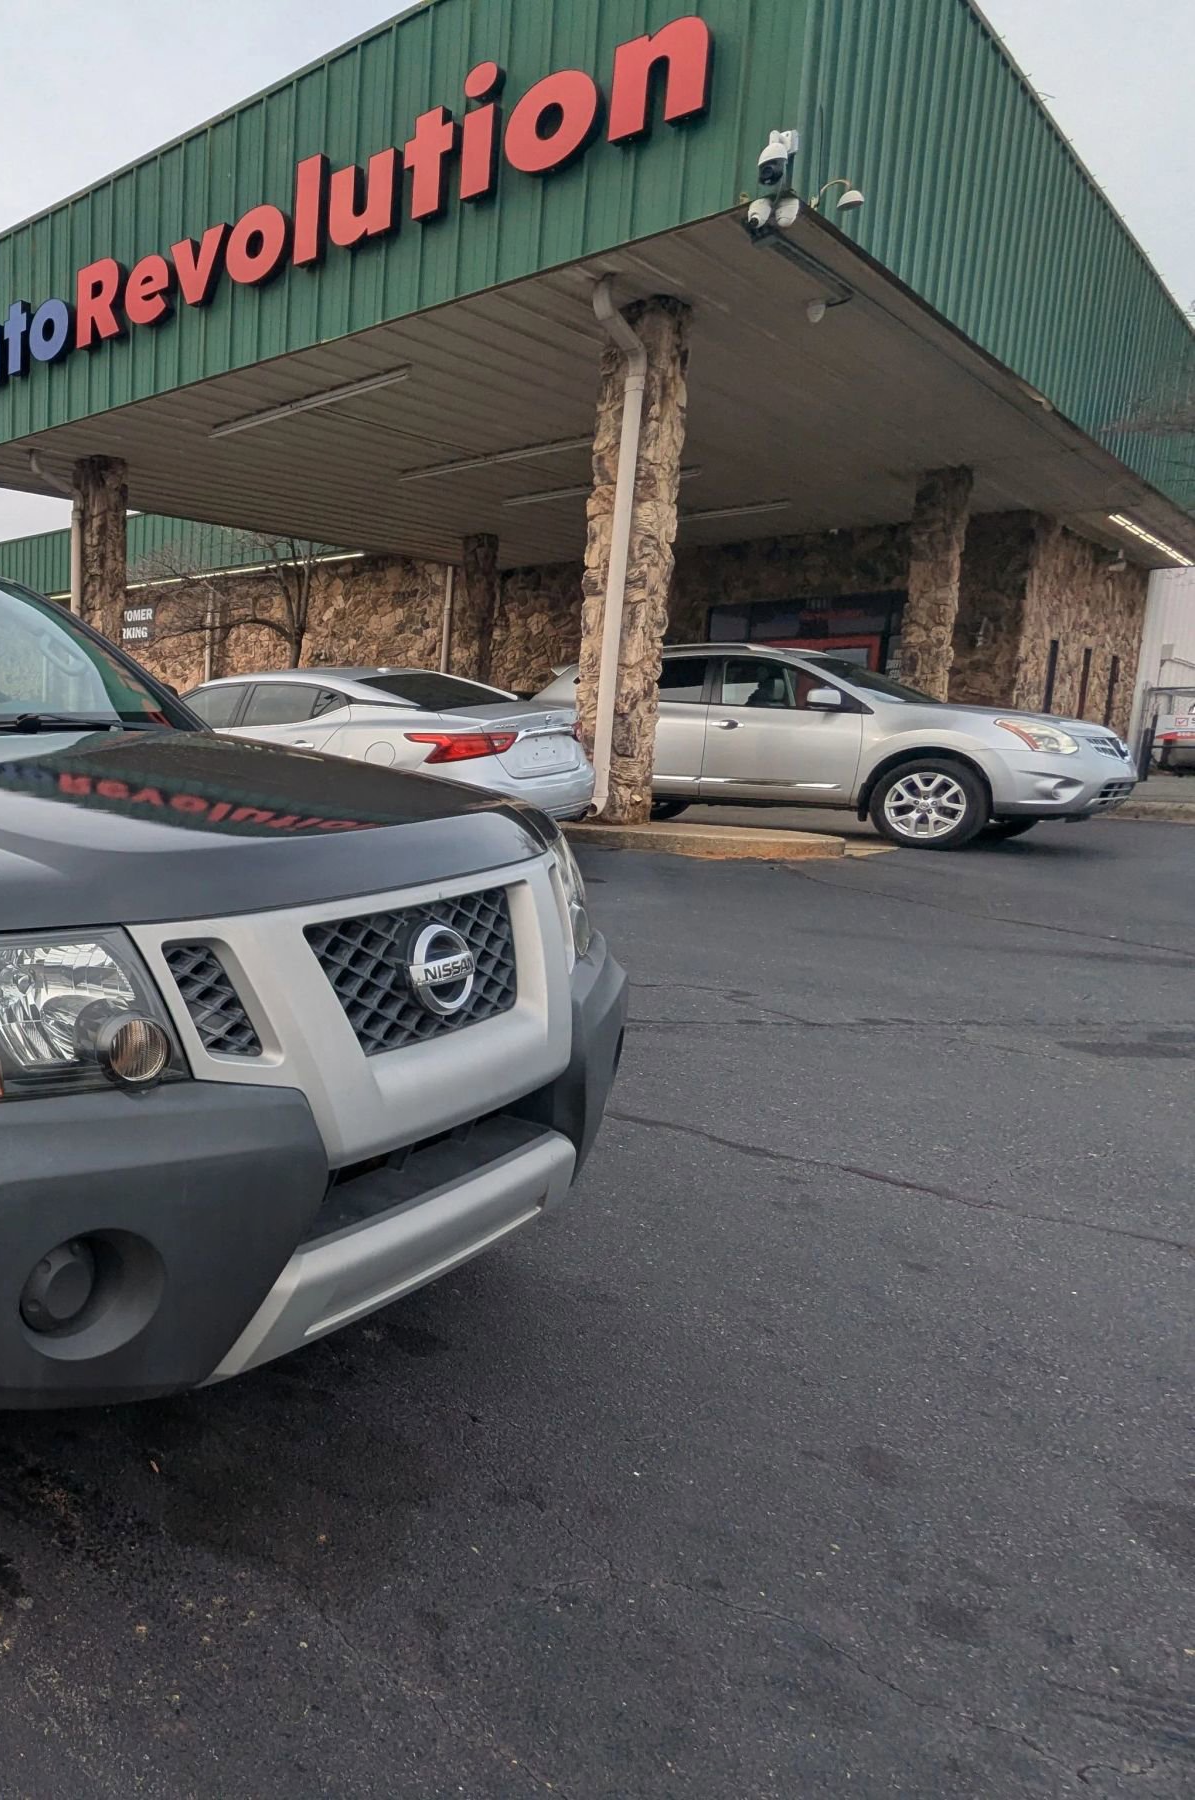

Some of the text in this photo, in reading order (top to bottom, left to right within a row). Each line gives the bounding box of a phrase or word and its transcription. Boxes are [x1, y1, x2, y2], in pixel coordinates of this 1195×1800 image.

[124, 608, 153, 622] TOMER
[122, 626, 148, 639] RKING
[423, 956, 474, 981] NISSAN
